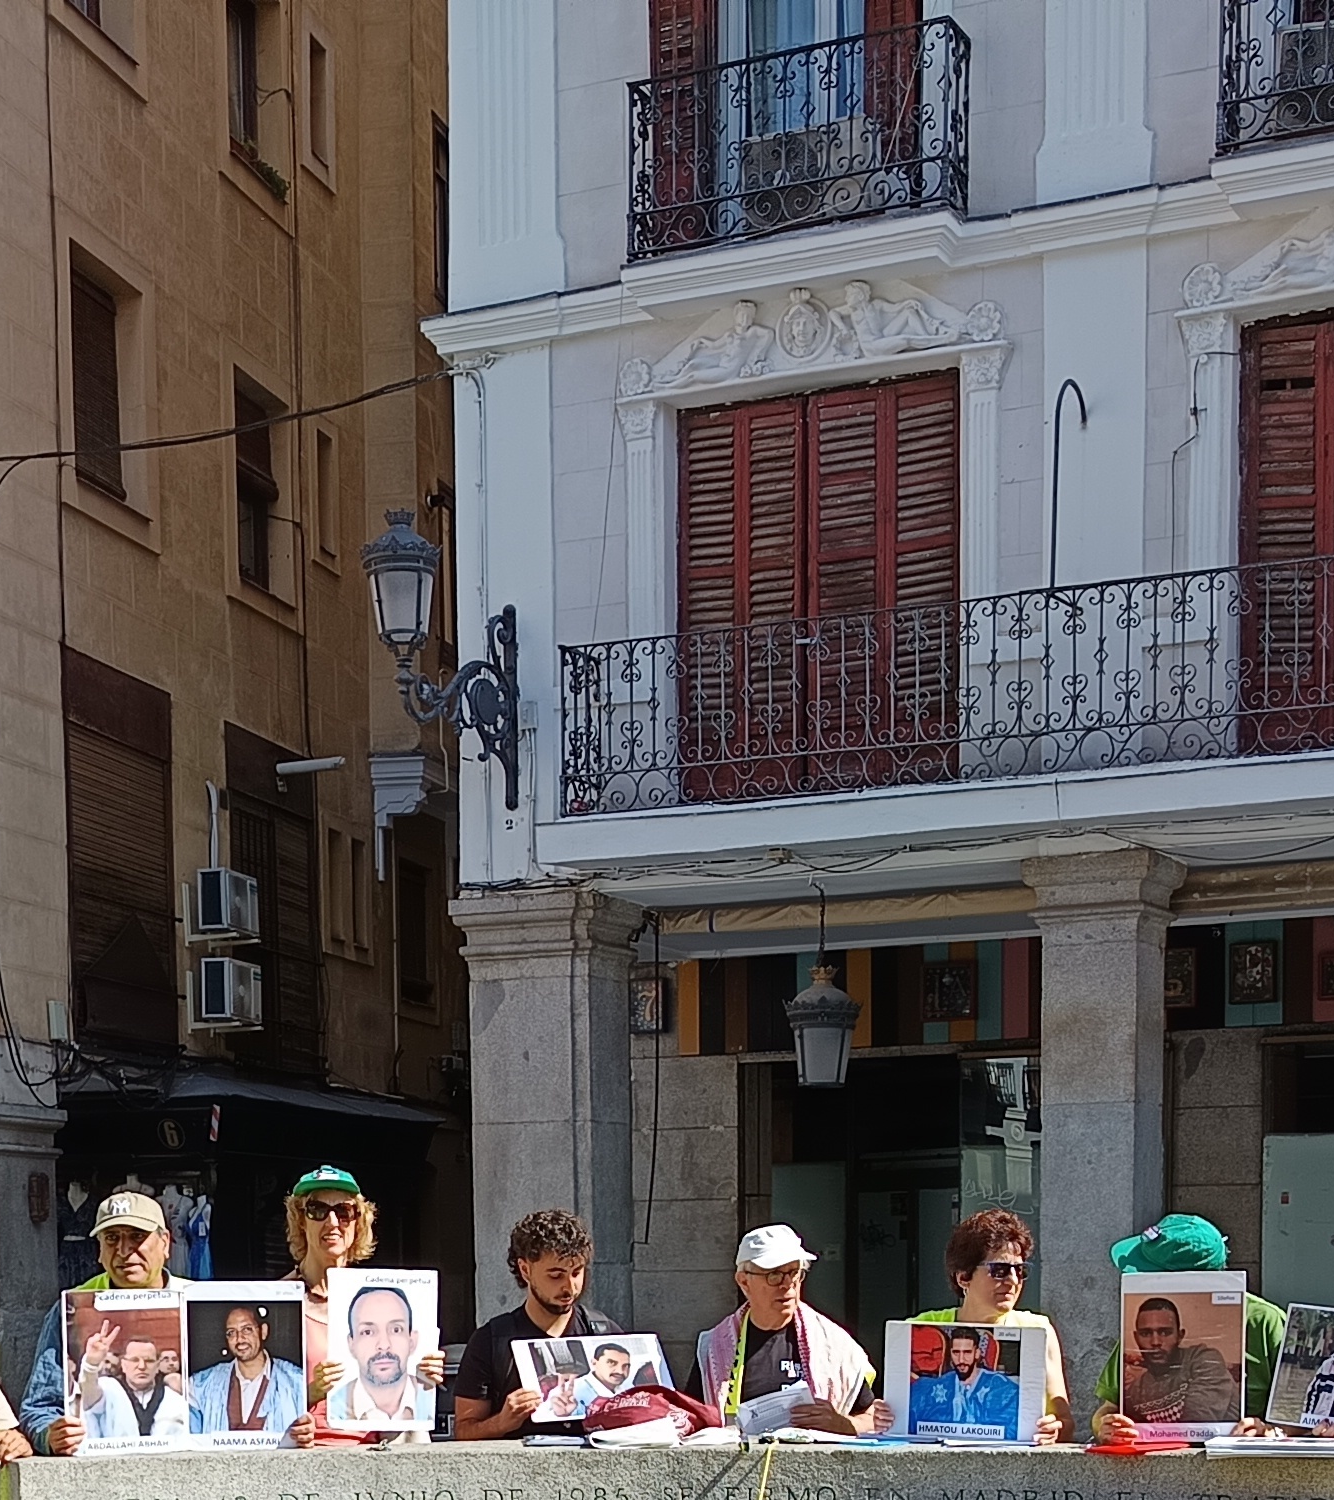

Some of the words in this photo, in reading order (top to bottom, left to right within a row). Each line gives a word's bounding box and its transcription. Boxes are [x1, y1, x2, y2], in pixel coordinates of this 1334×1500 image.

[918, 1424, 957, 1434] HMATOU
[961, 1426, 1001, 1436] LAKOUIRI
[1149, 1430, 1187, 1438] Mohamed
[1189, 1430, 1214, 1438] Dadda
[213, 1438, 247, 1447] NAAMA
